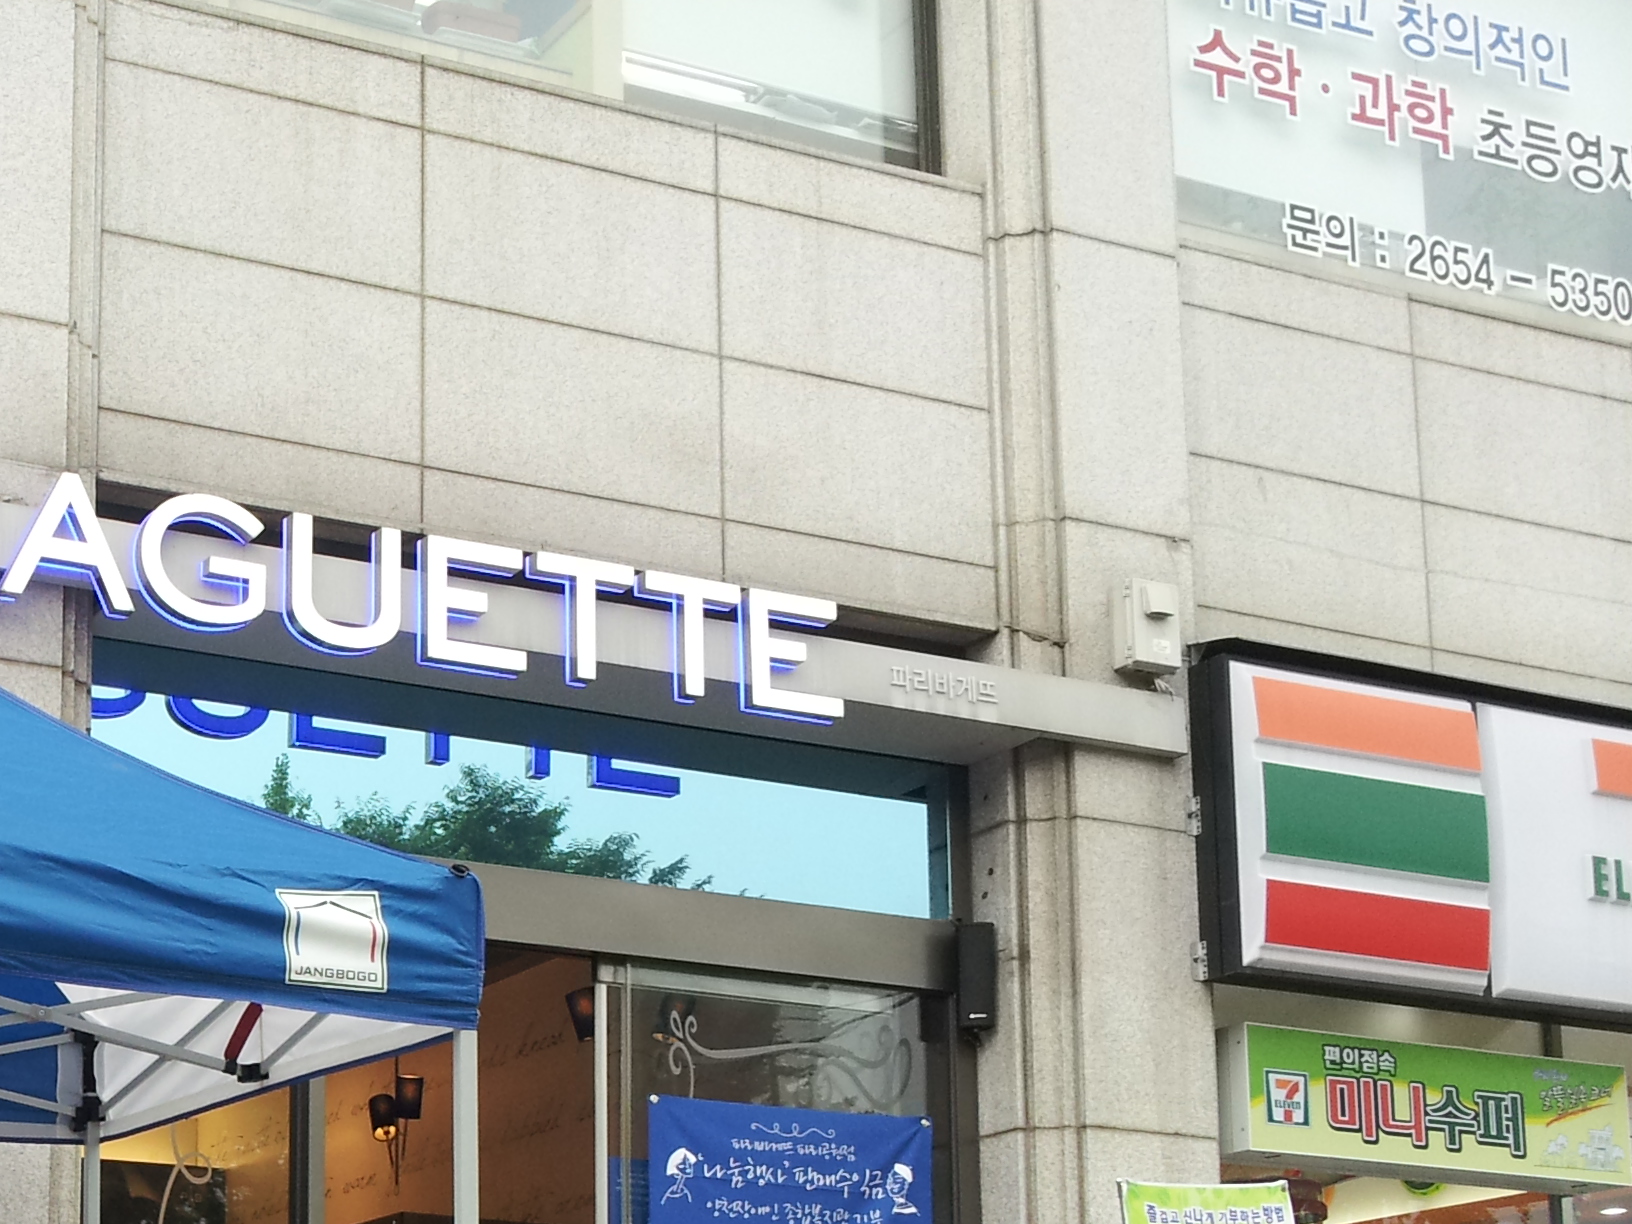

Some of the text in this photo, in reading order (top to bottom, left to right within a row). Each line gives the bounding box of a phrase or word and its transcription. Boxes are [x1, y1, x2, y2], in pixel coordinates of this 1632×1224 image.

[1397, 0, 1570, 92] 창의적인
[1286, 203, 1357, 263] 문의
[890, 665, 998, 703] 파리바게뜨
[294, 965, 378, 983] JANGBOGO
[1322, 1045, 1396, 1075] 편의점속
[1325, 1074, 1524, 1157] 미니수퍼
[793, 1166, 887, 1199] 판매수익금
[1146, 1204, 1180, 1224] 즐겁고
